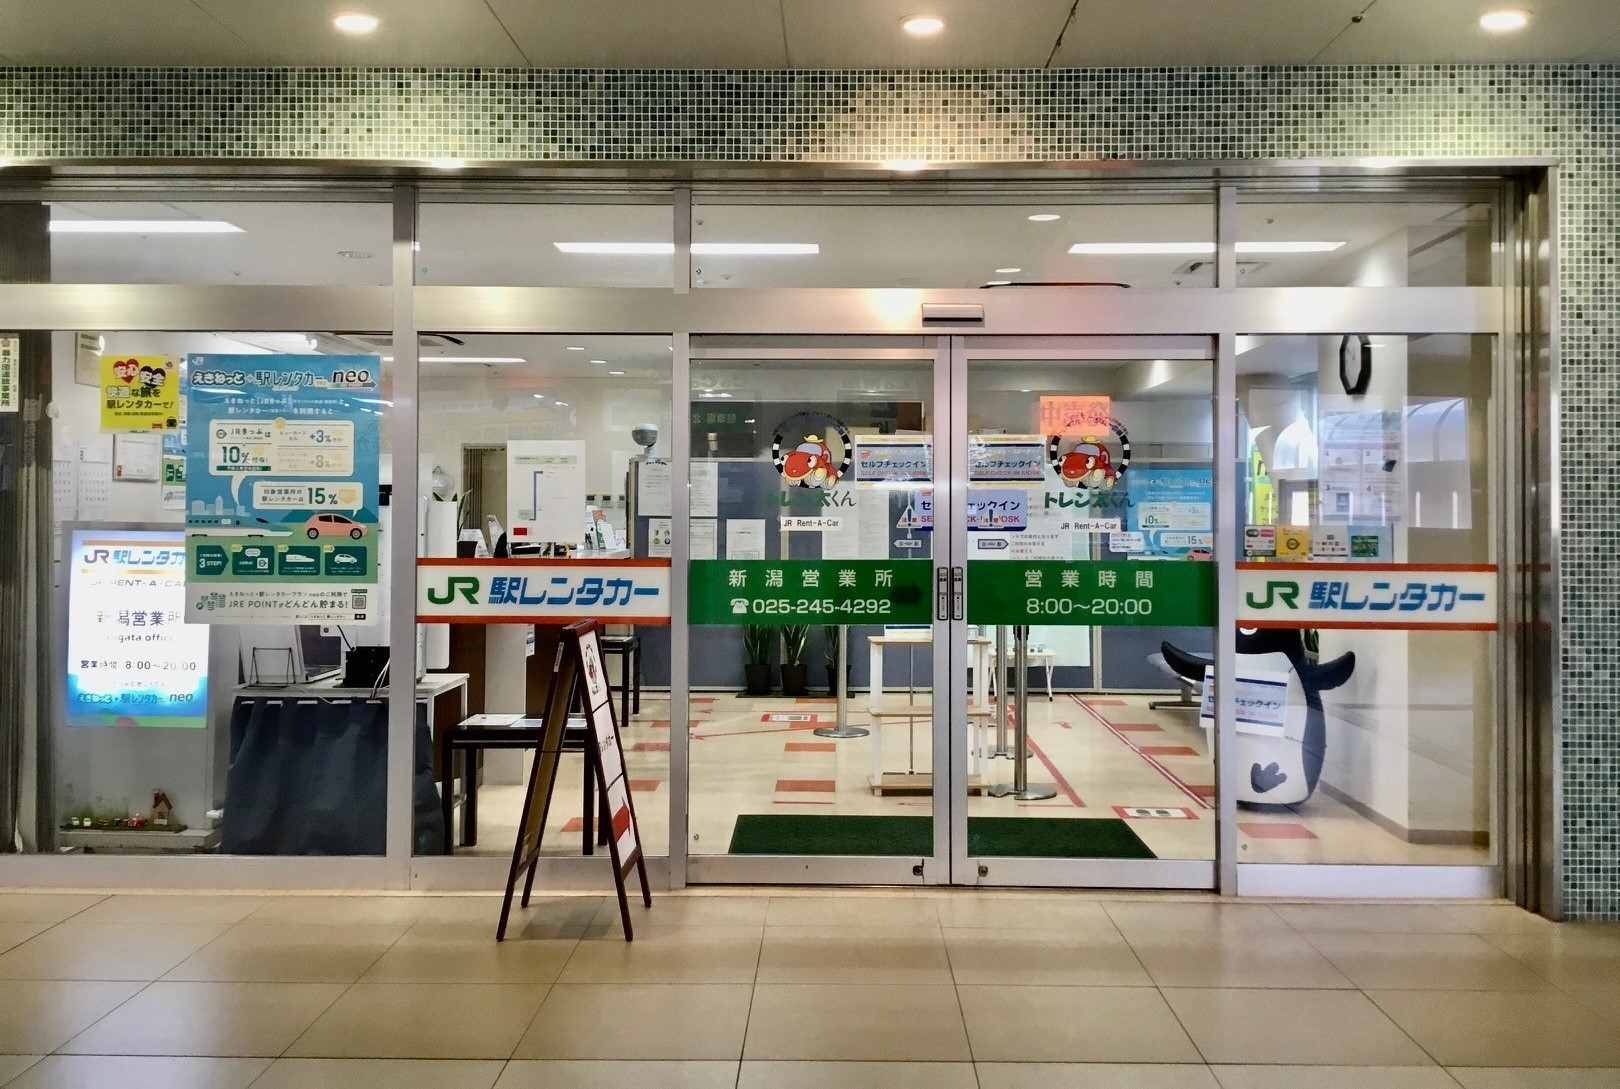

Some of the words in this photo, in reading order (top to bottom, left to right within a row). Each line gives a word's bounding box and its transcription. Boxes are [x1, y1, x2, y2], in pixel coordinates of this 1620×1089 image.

[192, 370, 246, 386] えきねっと
[255, 370, 324, 387] 駅レンタカー
[332, 369, 370, 383] neo
[106, 385, 161, 398] 快適な旅を
[222, 446, 250, 464] 10%
[308, 488, 338, 505] 15%
[84, 549, 110, 564] JR
[113, 550, 185, 565] 駅レンタカ
[729, 569, 893, 587] 新潟営業所
[1025, 570, 1154, 588] 営業時間
[427, 576, 480, 605] JR
[488, 576, 660, 606] 駅レンタカー
[1246, 581, 1300, 610] JR
[1308, 581, 1485, 612] 駅レンタカー
[229, 600, 244, 608] JRE
[752, 598, 891, 614] 025-245-4292
[169, 693, 193, 702] neo
